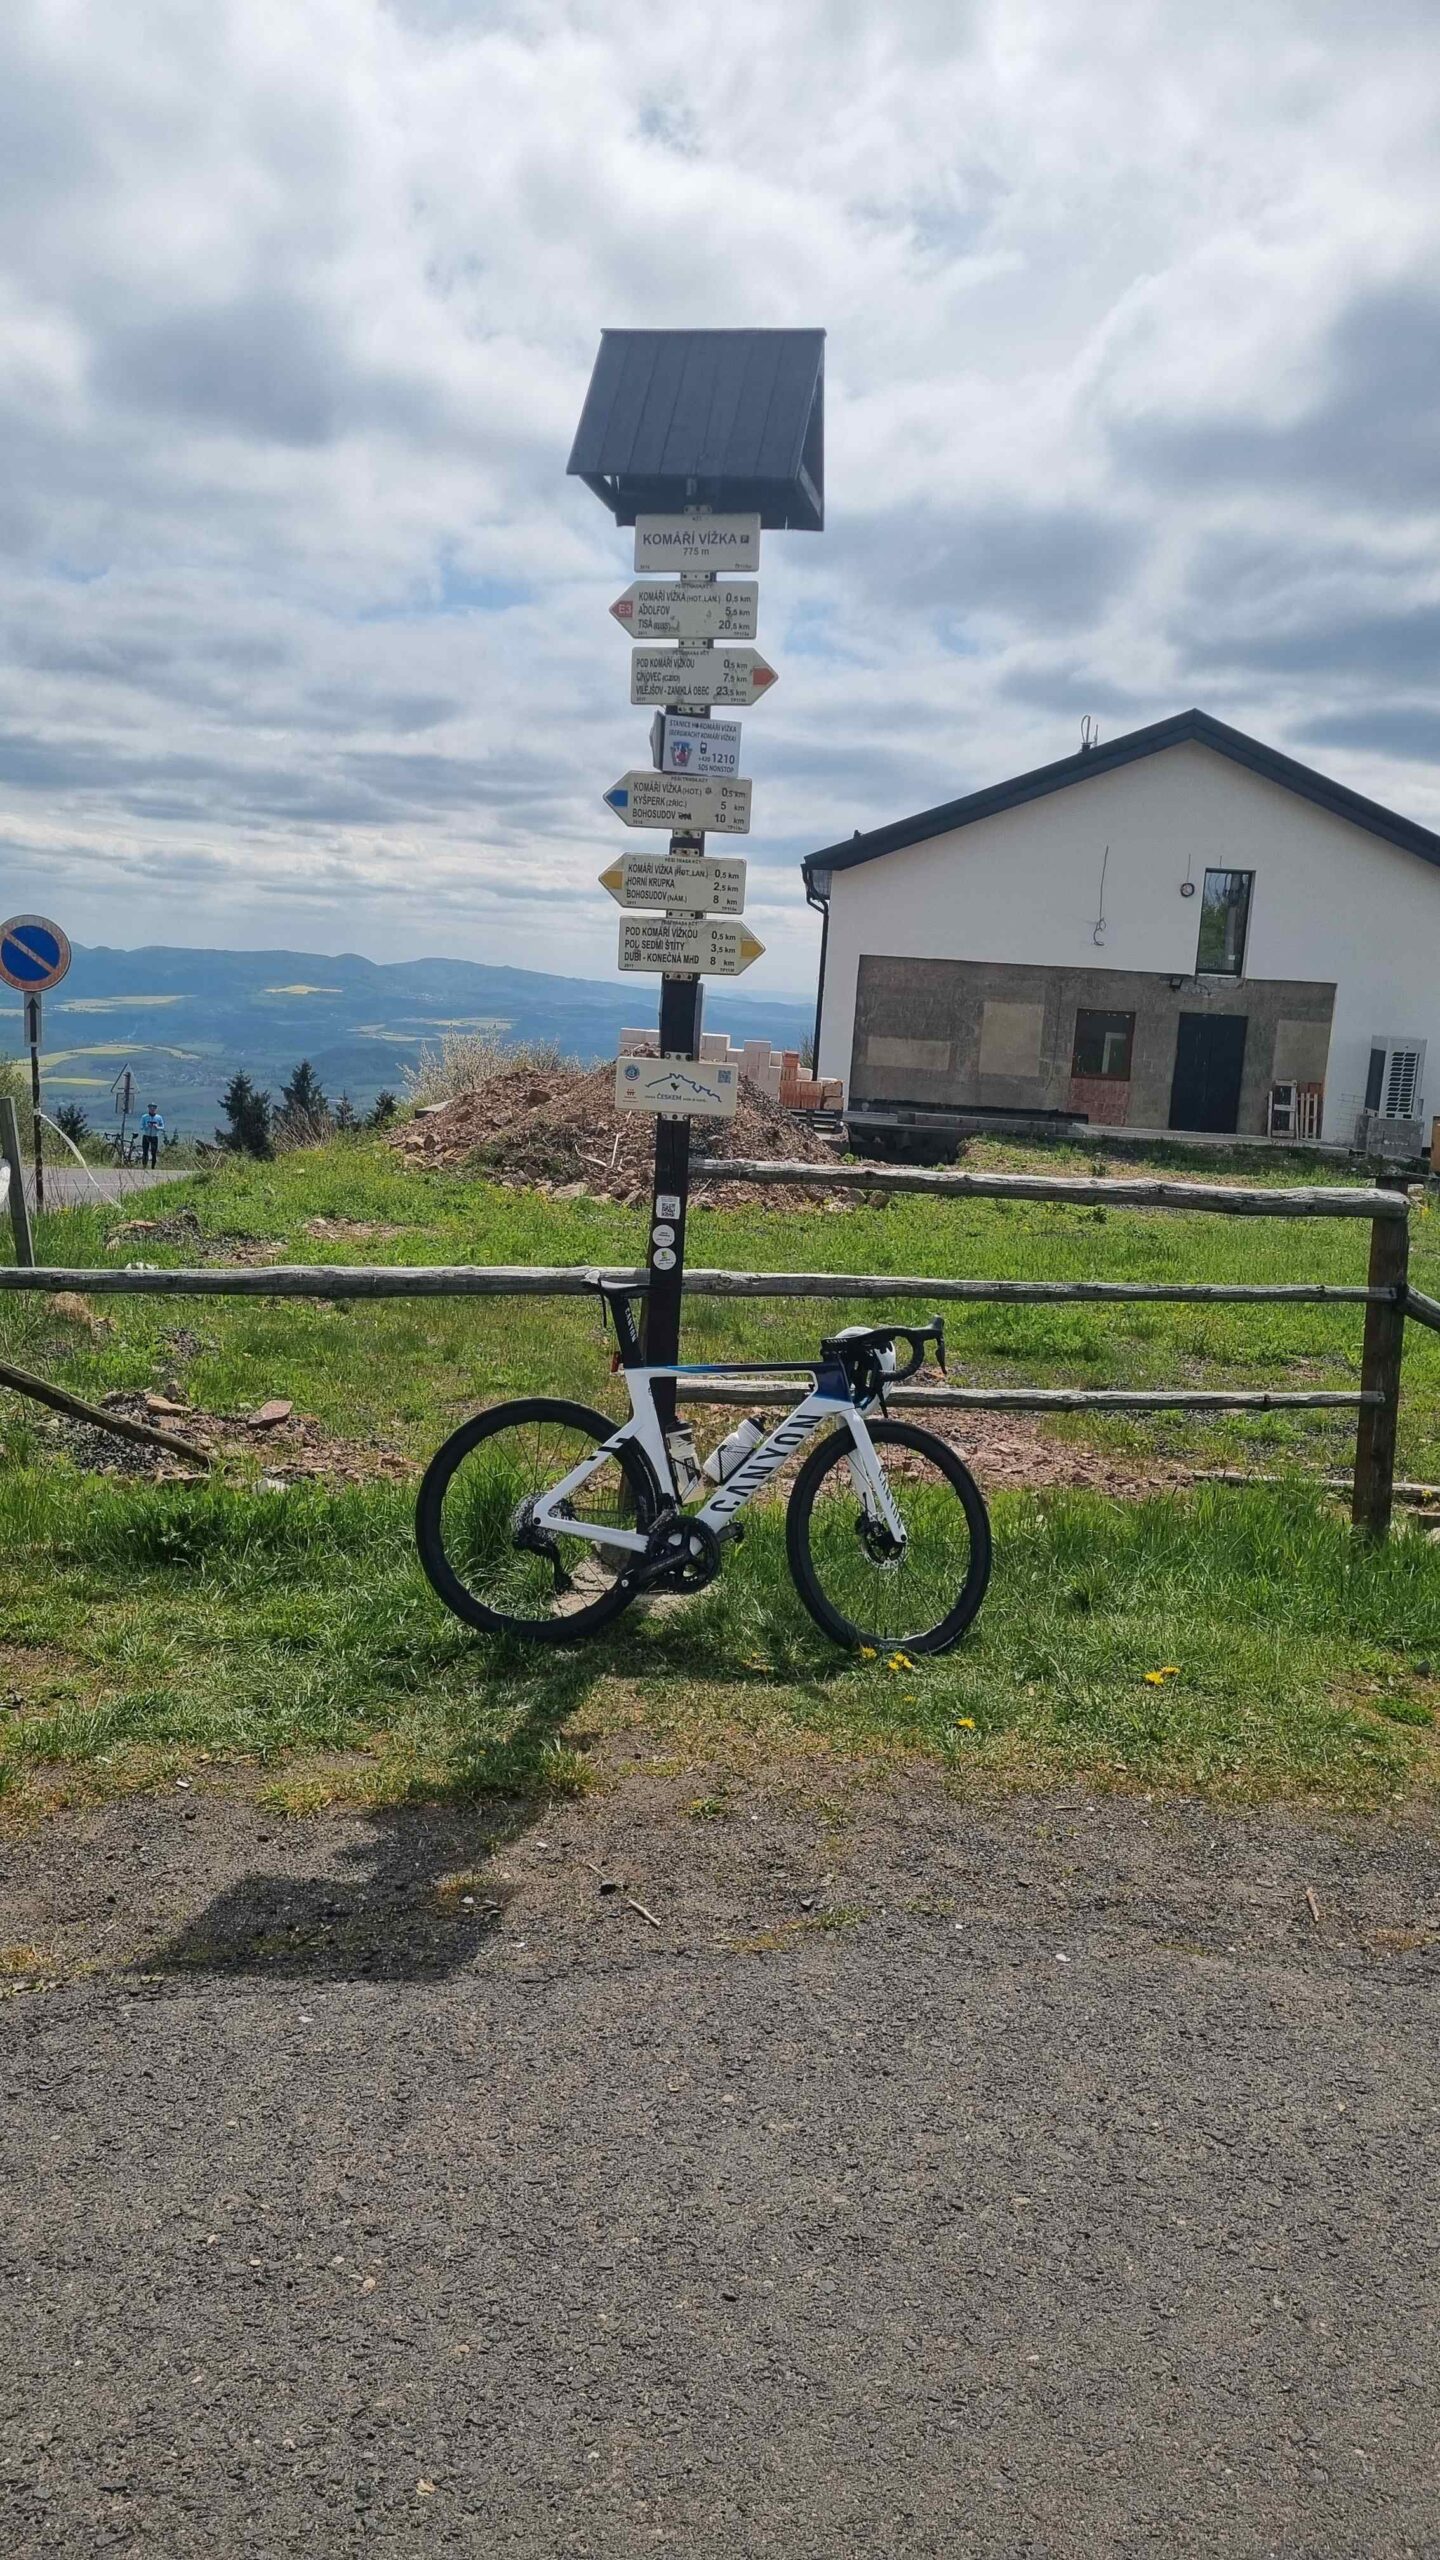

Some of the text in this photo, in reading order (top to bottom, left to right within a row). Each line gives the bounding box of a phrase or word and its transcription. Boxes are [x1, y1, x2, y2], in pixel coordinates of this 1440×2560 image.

[643, 530, 737, 545] KOMÁŘÍ VÍŽKA
[683, 547, 710, 556] 775 m
[639, 589, 665, 601] KOMÁŘÍ
[667, 590, 686, 601] VÍŽKA
[618, 604, 632, 614] E3
[638, 604, 670, 616] ADOLFOV
[718, 620, 737, 631] 20,5
[636, 658, 649, 668] POD
[650, 657, 672, 668] KOMÁŘÍ
[693, 686, 710, 696] OBEC
[716, 686, 734, 696] 23,5
[712, 753, 735, 764] 1210
[634, 781, 660, 792] KOMÁŘÍ
[662, 784, 682, 794] VÍŽKA
[633, 794, 666, 806] KYŠPERK
[720, 801, 727, 810] 5
[632, 808, 676, 820] BOHOSUDOV
[715, 813, 726, 823] 10
[628, 862, 654, 874] KOMÁŘÍ
[654, 864, 672, 875] VÍŽKA
[628, 876, 648, 886] HORNÍ
[649, 878, 675, 888] KRUPKA
[626, 889, 668, 900] BOHOSUDOV
[713, 895, 719, 904] 8
[625, 926, 640, 936] POD
[642, 926, 670, 938] KOMÁŘÍ
[672, 928, 698, 938] VÍŽKOU
[642, 940, 664, 950] SEDMI
[665, 940, 685, 950] ŠTÍTY
[624, 951, 642, 961] DUBÍ
[647, 952, 682, 964] KONEČNÁ
[683, 955, 700, 964] MHD
[710, 956, 716, 966] 8
[625, 1308, 636, 1342] CANYON
[710, 1414, 824, 1513] CANYON
